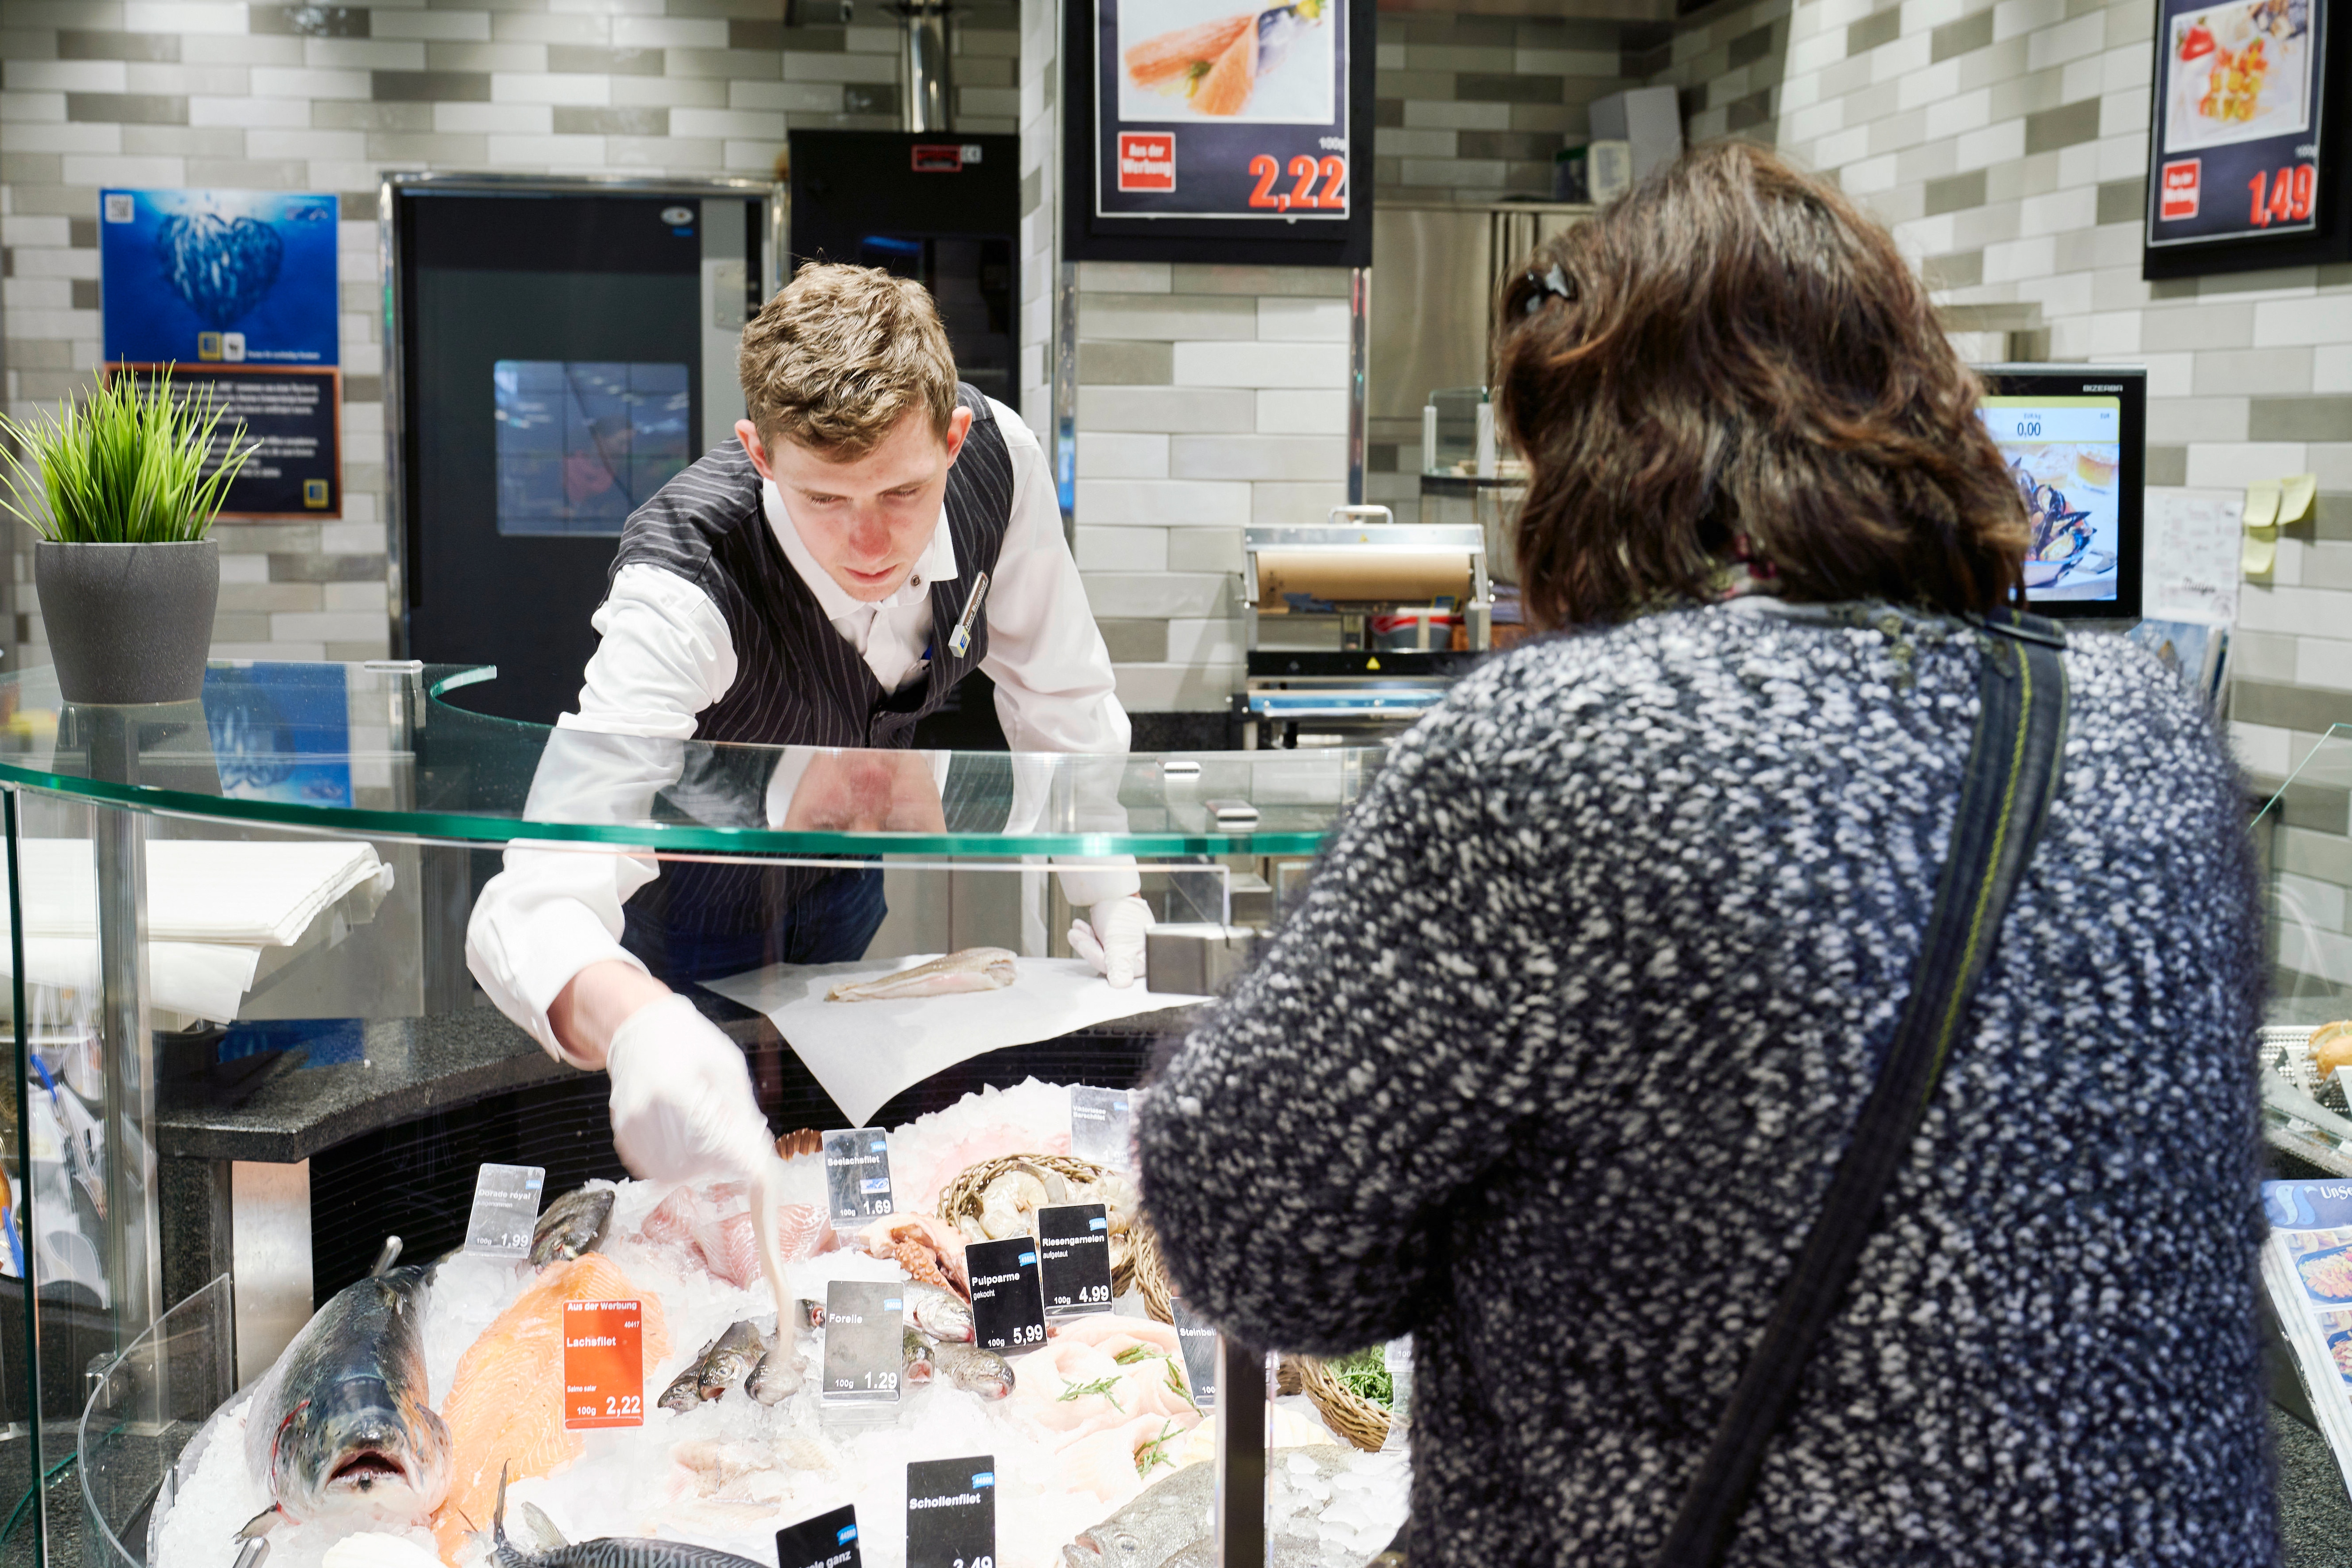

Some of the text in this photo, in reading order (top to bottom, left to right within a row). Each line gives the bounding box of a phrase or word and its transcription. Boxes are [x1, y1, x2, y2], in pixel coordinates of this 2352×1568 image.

[1248, 154, 1345, 213] 2,22
[2248, 163, 2316, 229] 1,49
[2017, 422, 2041, 438] 0,00
[965, 613, 974, 630] Herr
[827, 1155, 880, 1166] Seelachsfilet
[478, 1188, 531, 1200] Dorade royal
[863, 1199, 891, 1215] 1.69
[501, 1233, 529, 1249] 1,99
[1042, 1234, 1104, 1247] Riesengarnelen
[1043, 1250, 1068, 1259] aufgetaut
[971, 1273, 1020, 1287] Pulpoarme
[973, 1289, 995, 1301] gekocht
[1054, 1285, 1109, 1305] 100g 4.99
[584, 1302, 599, 1311] der
[600, 1302, 637, 1311] Werbung
[829, 1313, 863, 1324] Forelle
[567, 1336, 616, 1347] Lachsfilet
[988, 1324, 1043, 1347] 100g 5,99
[835, 1371, 898, 1389] 100g 1.29
[577, 1395, 641, 1417] 100g 2,22
[909, 1493, 981, 1510] Schollenfilet
[826, 1550, 851, 1568] ganz
